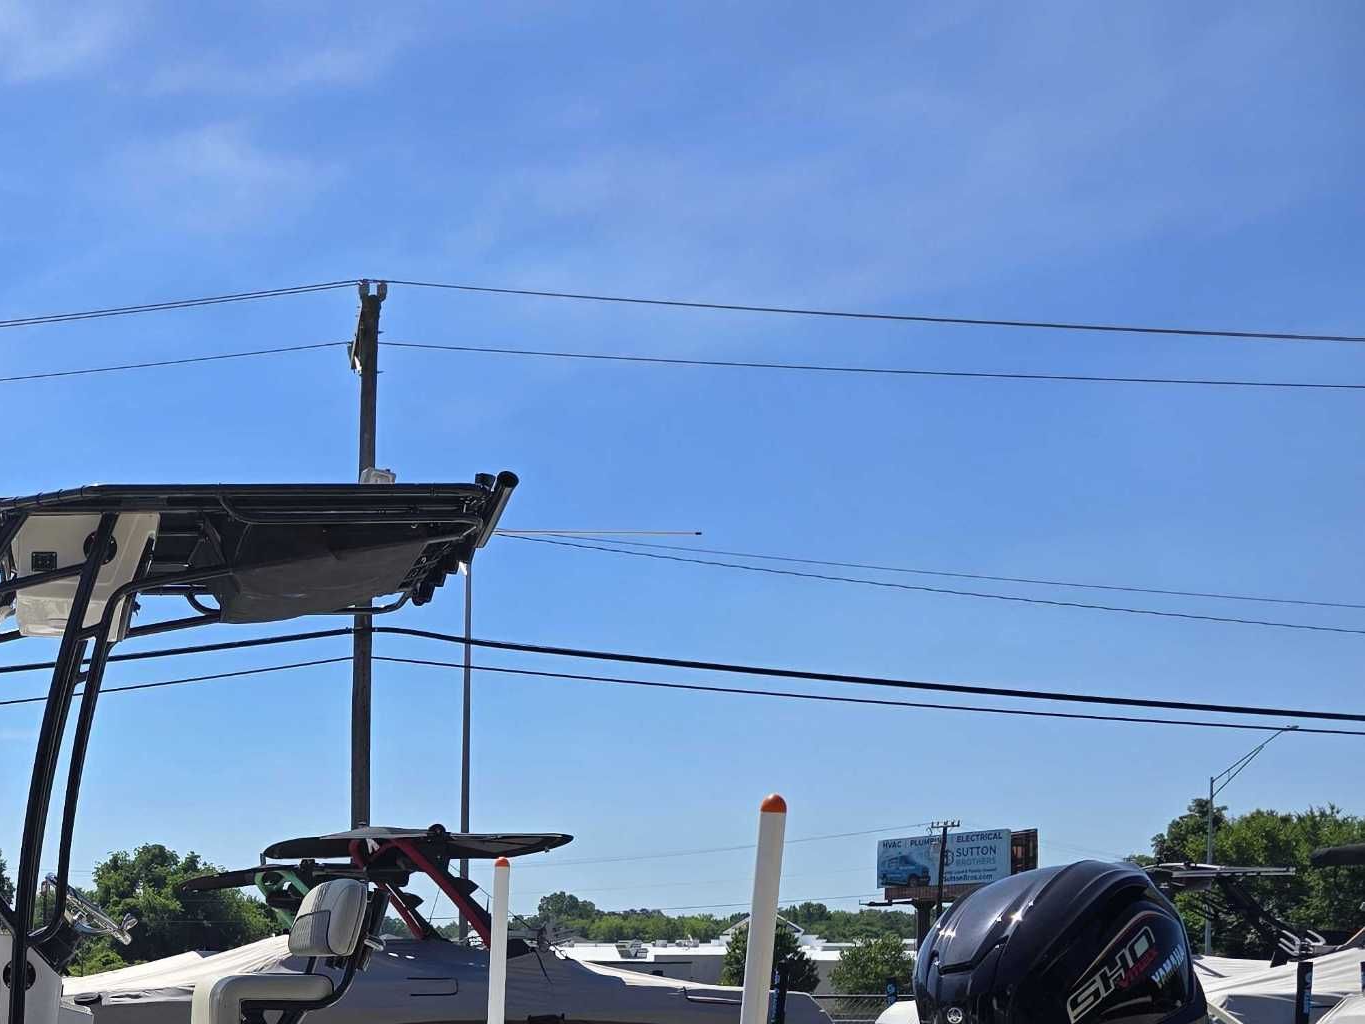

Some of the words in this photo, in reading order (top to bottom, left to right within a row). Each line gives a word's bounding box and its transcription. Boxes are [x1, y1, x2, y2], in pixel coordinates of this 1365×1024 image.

[883, 840, 902, 848] HVAC
[956, 832, 1003, 843] ELECTRICAL
[956, 846, 997, 857] SUTTON
[956, 857, 997, 866] BROTHERS
[1150, 943, 1186, 987] YAMAHA
[1067, 926, 1155, 1024] SHO
